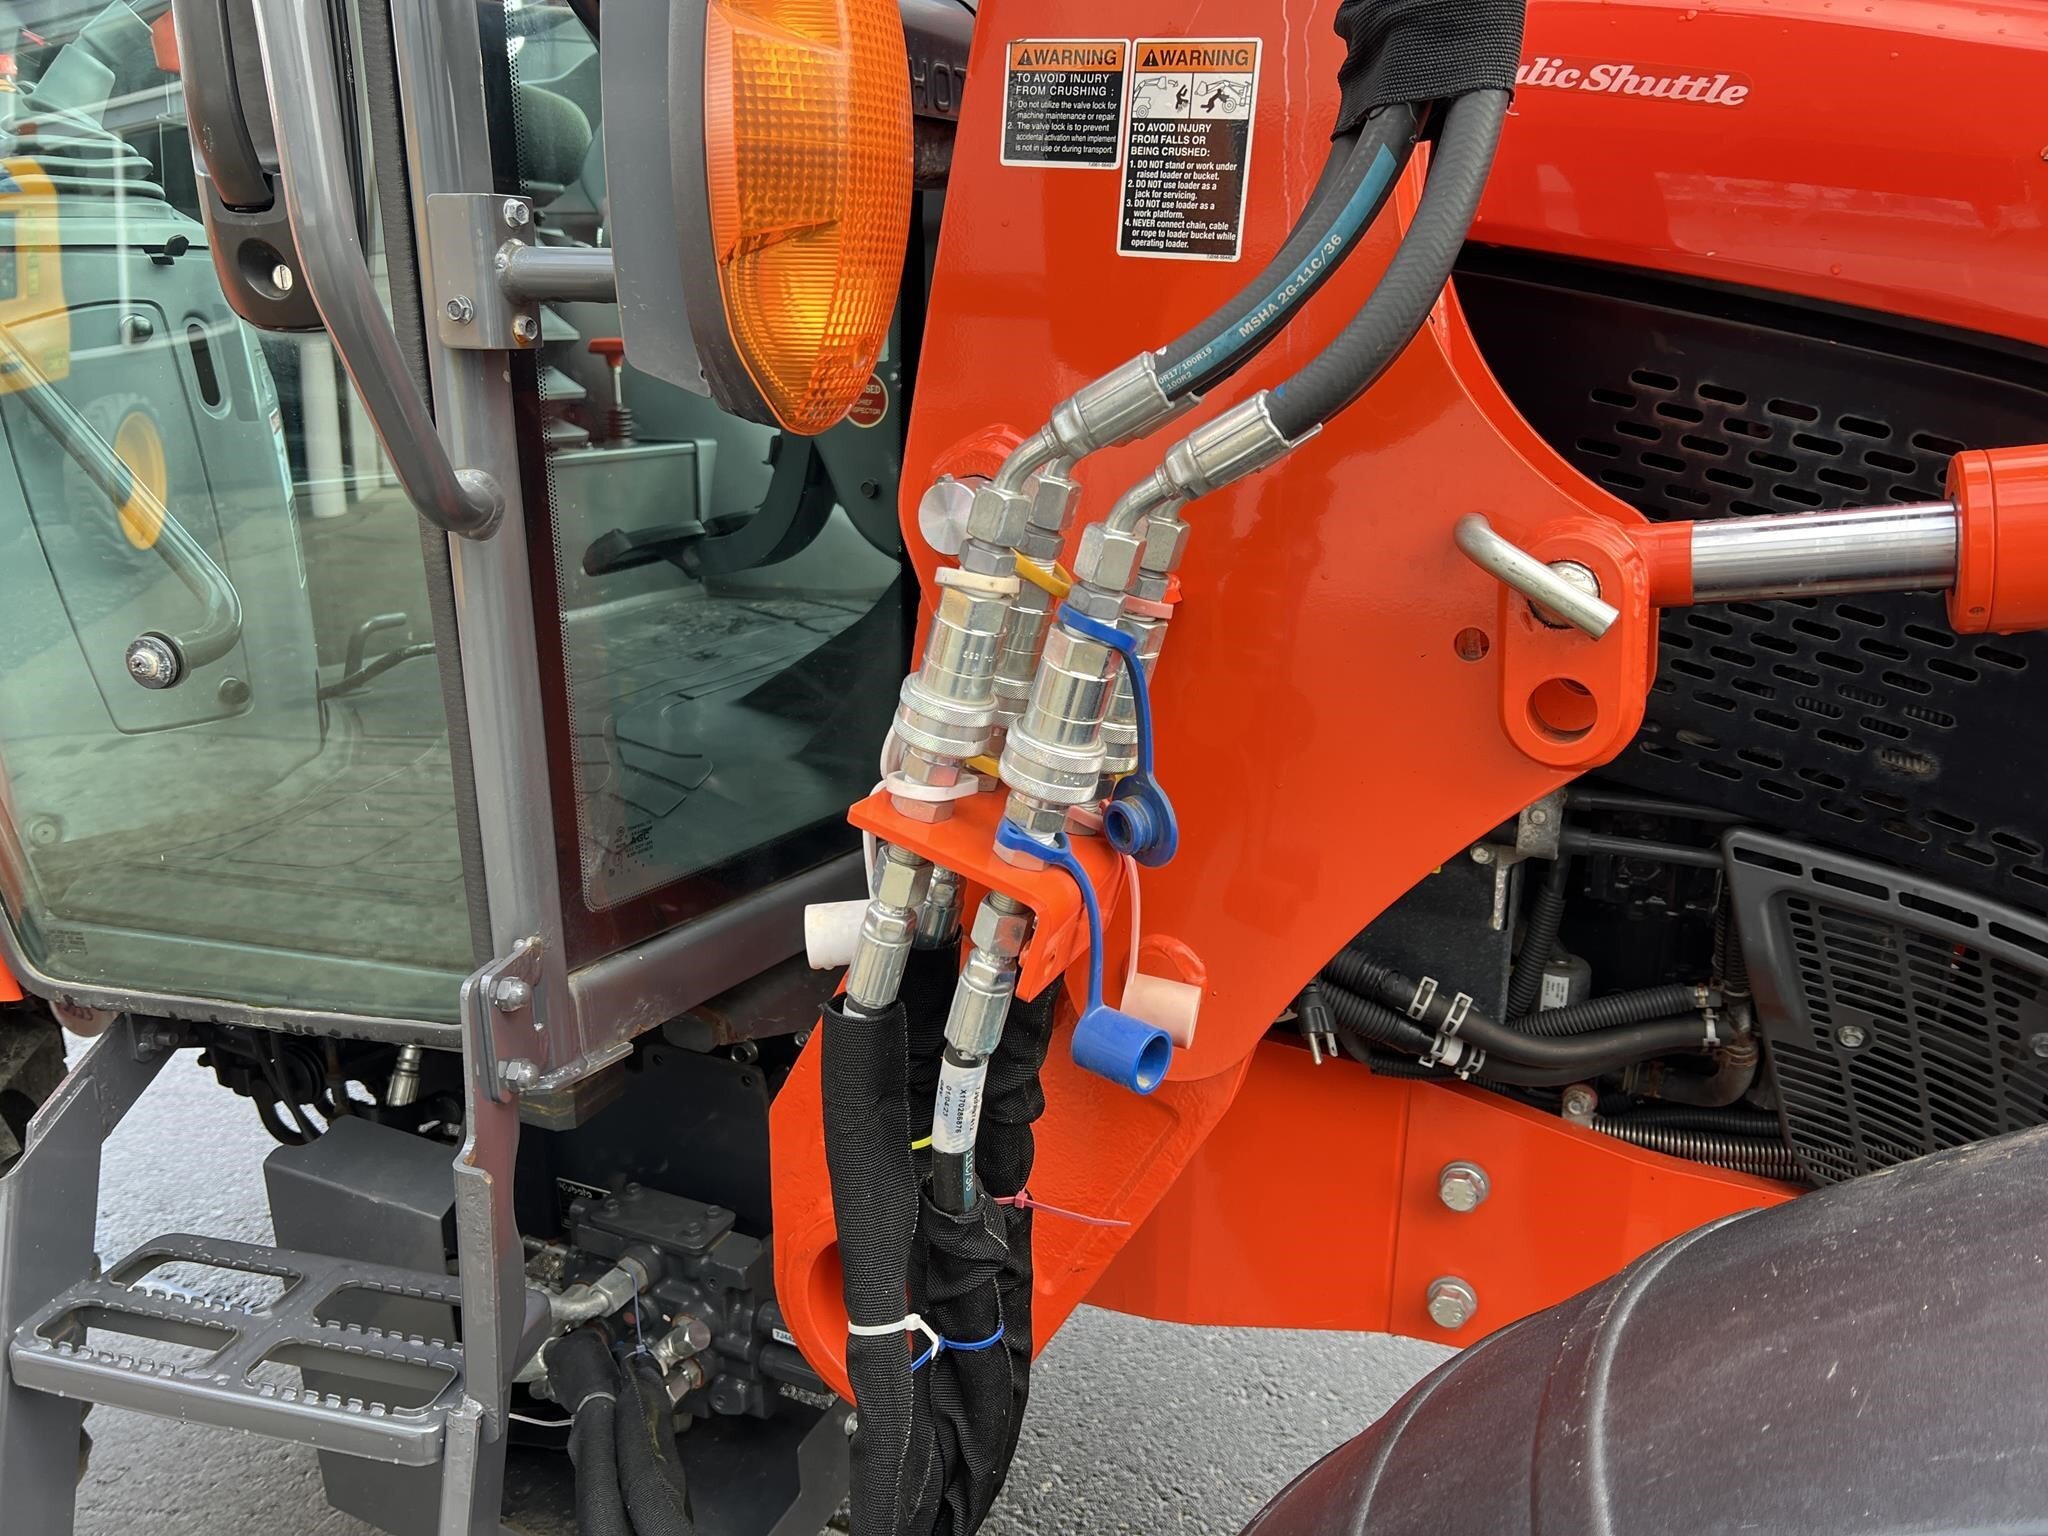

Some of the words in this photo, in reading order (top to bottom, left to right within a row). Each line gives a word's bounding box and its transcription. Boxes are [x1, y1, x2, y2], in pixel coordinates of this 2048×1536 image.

[1034, 49, 1117, 65] WARNING
[1160, 49, 1248, 66] WARNING
[1016, 73, 1031, 83] TO
[1034, 73, 1066, 83] AVOID
[1070, 73, 1109, 83] INJURY
[1579, 64, 1748, 105] Shuttle
[1016, 86, 1046, 95] FROM
[1049, 86, 1107, 96] CRUSHING
[1041, 101, 1060, 109] utilize
[1061, 101, 1072, 109] the
[1073, 101, 1091, 109] valve
[1092, 101, 1106, 109] lock
[1107, 101, 1117, 109] for
[1017, 111, 1044, 119] machine
[1045, 111, 1086, 120] maintenance
[1031, 122, 1050, 130] valve
[1051, 122, 1065, 130] lock
[1066, 122, 1073, 131] is
[1074, 123, 1081, 131] to
[1083, 123, 1110, 132] prevent
[1132, 122, 1145, 132] TO
[1147, 123, 1175, 132] AVOID
[1177, 123, 1211, 133] INJURY
[1016, 133, 1044, 141] accidental
[1044, 133, 1070, 142] activation
[1071, 134, 1086, 142] when
[1087, 134, 1116, 143] implement
[1131, 135, 1159, 144] FROM
[1160, 135, 1189, 145] FALLS
[1191, 135, 1206, 145] OR
[1033, 144, 1039, 152] in
[1061, 145, 1081, 154] during
[1130, 147, 1159, 156] BEING
[1161, 147, 1210, 157] CRUSHED:
[1130, 160, 1136, 168] 1.
[1137, 160, 1148, 169] DO
[1149, 160, 1164, 169] NOT
[1165, 160, 1185, 170] stand
[1186, 162, 1195, 170] or
[1196, 161, 1214, 170] work
[1216, 162, 1237, 171] under
[1136, 170, 1159, 179] raised
[1160, 171, 1182, 179] loader
[1193, 171, 1219, 180] bucket.
[1135, 180, 1146, 188] DO
[1147, 180, 1162, 189] NOT
[1177, 181, 1200, 190] loader
[1134, 190, 1150, 199] jack
[1151, 190, 1162, 198] for
[1163, 191, 1198, 200] servicing.
[1126, 200, 1133, 208] 3.
[1134, 200, 1145, 208] DO
[1146, 200, 1161, 208] NOT
[1176, 200, 1198, 210] loader
[1133, 210, 1151, 218] work
[1152, 210, 1185, 220] platform.
[1124, 219, 1131, 227] 4.
[1132, 219, 1155, 228] NEVER
[1156, 221, 1185, 229] connect
[1186, 221, 1208, 230] chain,
[1209, 221, 1229, 230] cable
[1132, 229, 1140, 237] or
[1141, 230, 1157, 239] rope
[1167, 230, 1189, 239] loader
[1190, 231, 1215, 240] bucket
[1216, 232, 1236, 240] while
[1131, 239, 1164, 249] operating
[1165, 239, 1189, 248] loader.
[1238, 303, 1279, 337] MSHA
[1278, 234, 1343, 305] 2G-11C/36
[1166, 371, 1193, 391] 100R2
